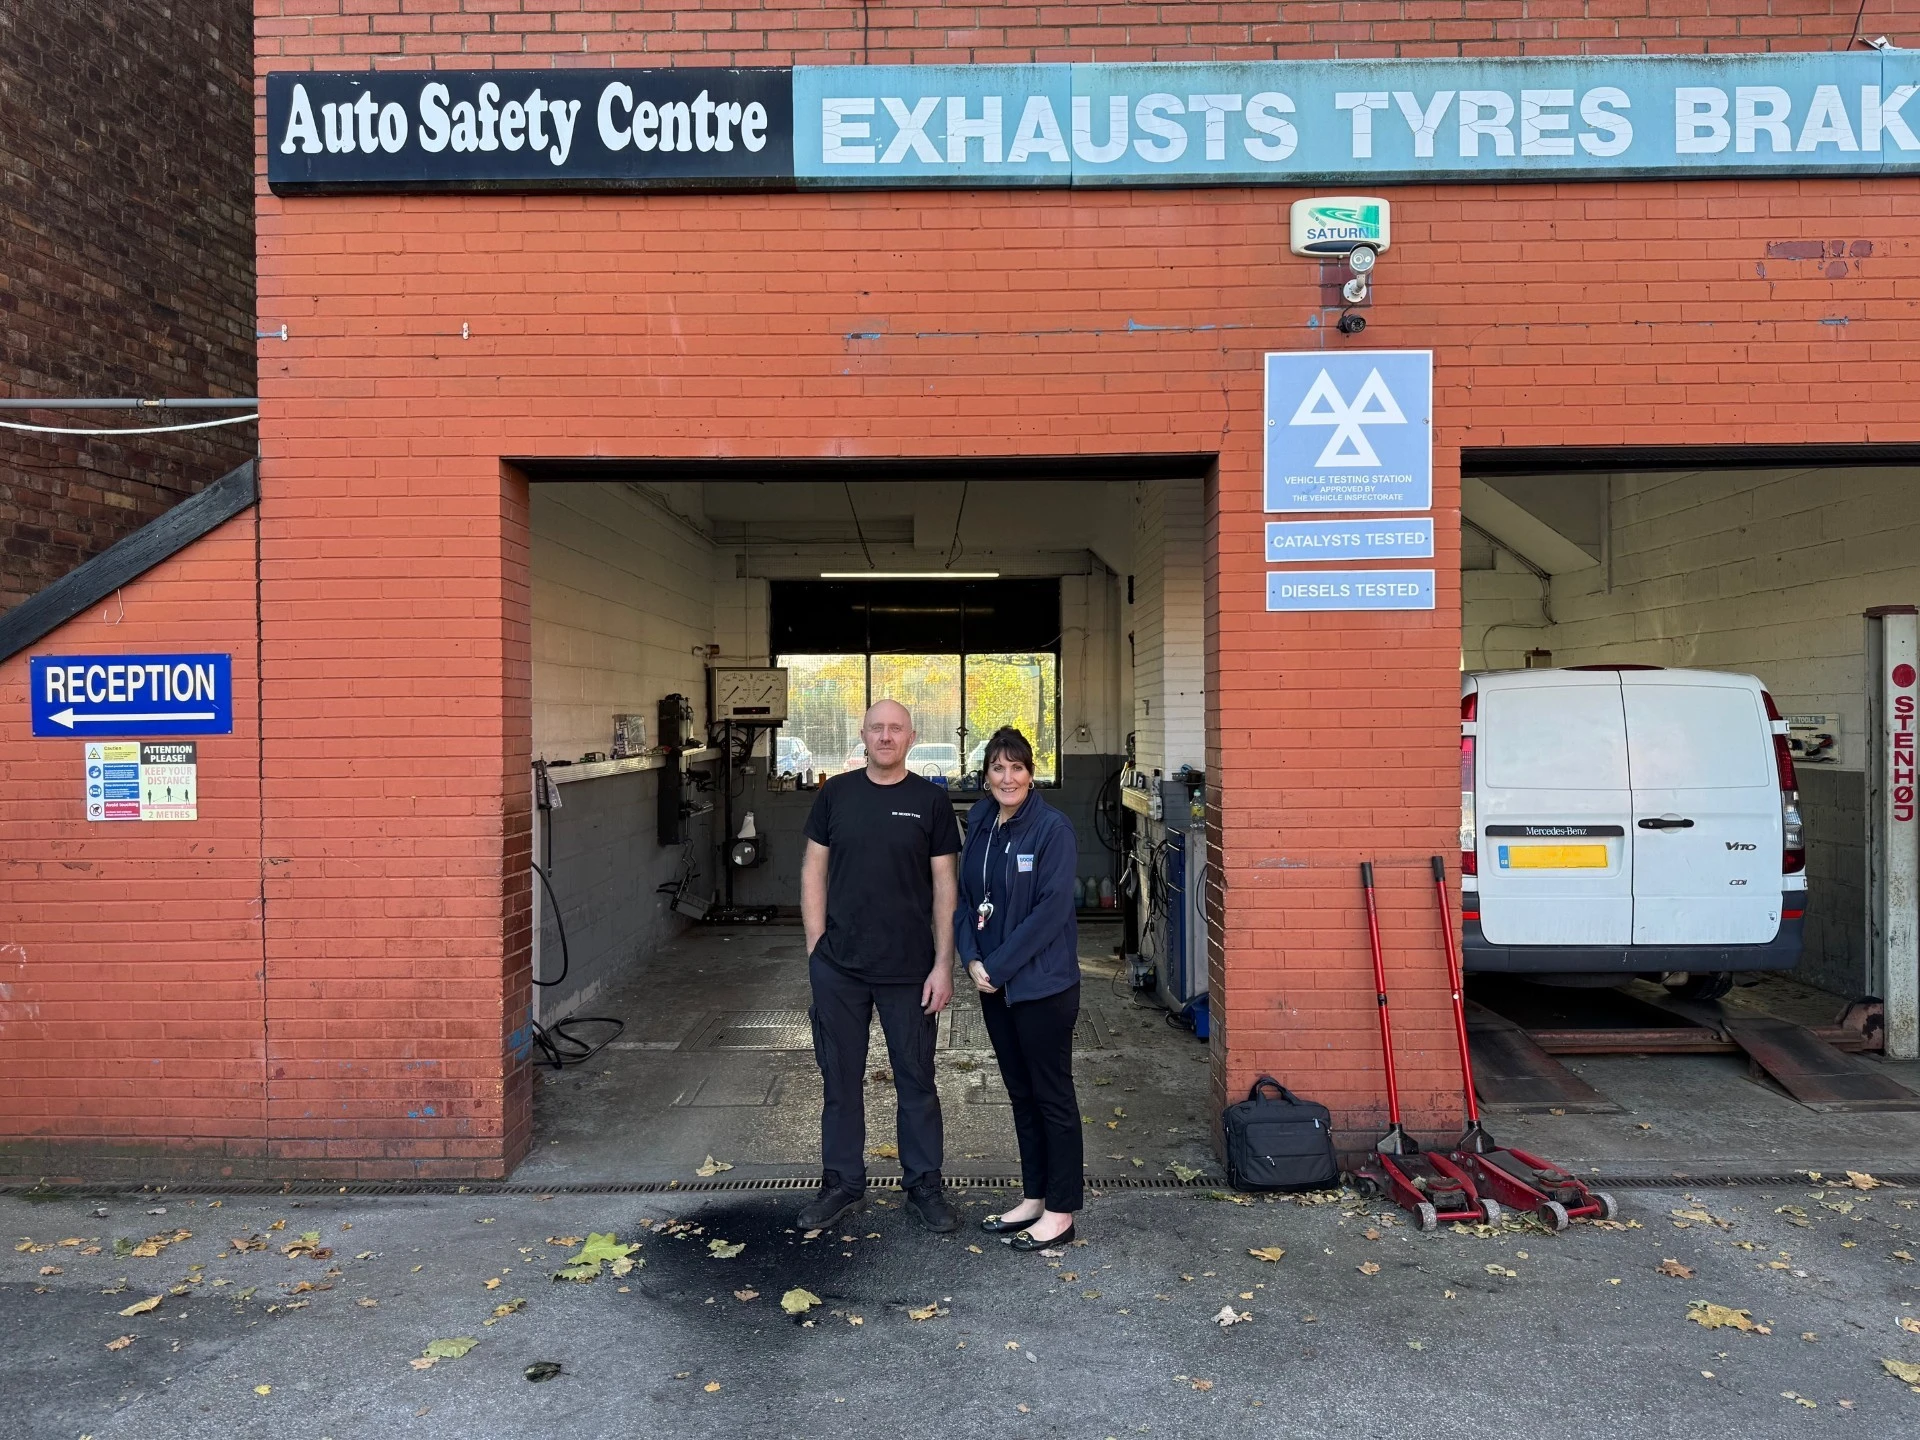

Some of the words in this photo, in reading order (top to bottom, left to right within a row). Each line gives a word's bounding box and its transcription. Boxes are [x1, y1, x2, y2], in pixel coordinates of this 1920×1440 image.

[281, 83, 408, 154] Auto
[419, 82, 581, 166] Safety
[597, 81, 768, 152] Centre
[822, 91, 1298, 164] EXHAUSTS
[1335, 87, 1634, 158] TYRES
[1676, 84, 1920, 153] BRAK
[1307, 227, 1369, 240] SATURN
[1284, 475, 1325, 485] VEHICLE
[1328, 475, 1370, 484] TESTING
[1371, 474, 1412, 483] STATION
[1309, 494, 1343, 502] VEHICLE
[1344, 493, 1403, 501] INSPECTORATE
[1273, 534, 1361, 548] CATALYSTS
[1365, 532, 1425, 546] TESTED
[1281, 584, 1350, 598] DIESELS
[1355, 583, 1420, 597] TESTED
[46, 663, 215, 703] RECEPTION
[143, 745, 193, 754] ATTENTION
[150, 754, 186, 763] PLEASE!
[1893, 695, 1915, 822] STENHØJ
[144, 766, 167, 776] KEEP
[168, 766, 192, 776] YOUR
[147, 776, 191, 785] DISTANCE
[156, 810, 191, 819] METRES
[1526, 826, 1588, 836] Mercedes-Benz
